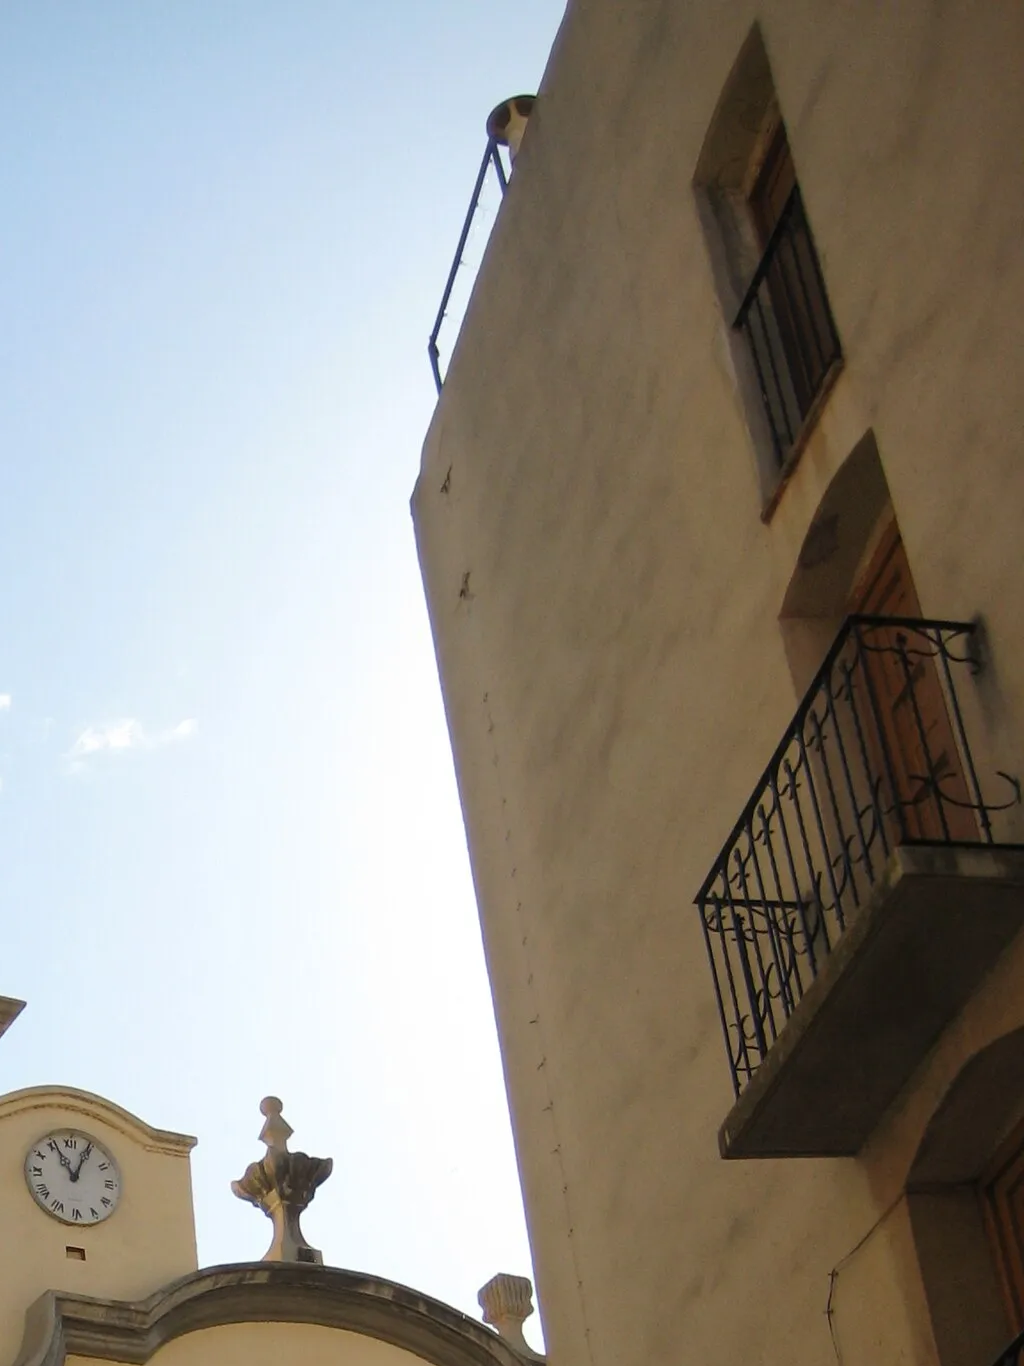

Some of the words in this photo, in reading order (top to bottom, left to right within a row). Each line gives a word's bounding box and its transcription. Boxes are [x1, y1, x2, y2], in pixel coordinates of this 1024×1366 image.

[64, 1139, 76, 1150] XII
[36, 1150, 46, 1160] X
[33, 1166, 42, 1177] IX
[98, 1163, 108, 1172] II
[105, 1180, 114, 1190] III
[36, 1183, 50, 1200] VIII
[51, 1199, 64, 1214] VII
[72, 1208, 82, 1221] VI
